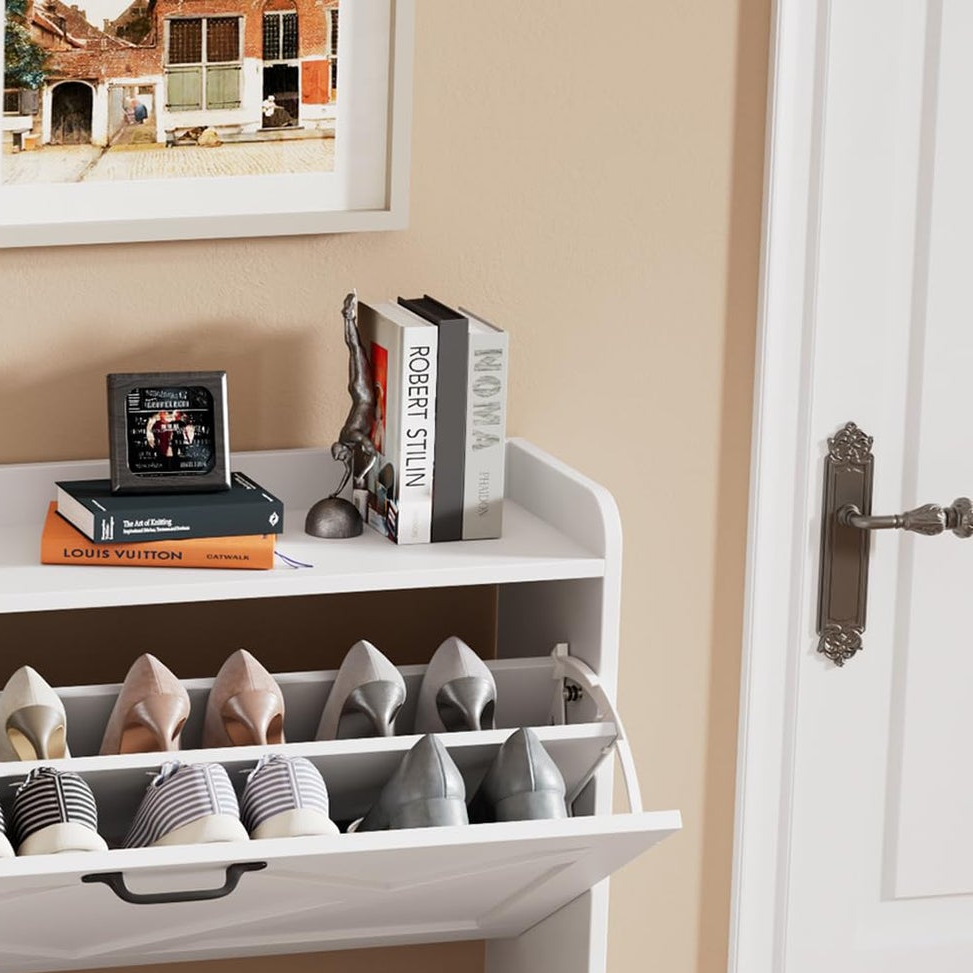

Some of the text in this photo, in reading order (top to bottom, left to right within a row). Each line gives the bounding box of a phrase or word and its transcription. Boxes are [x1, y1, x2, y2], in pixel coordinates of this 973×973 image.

[405, 346, 430, 488] ROBERT STILIN
[472, 348, 503, 452] NOMA
[63, 548, 250, 561] LOUIS VUITTON CATWALK
